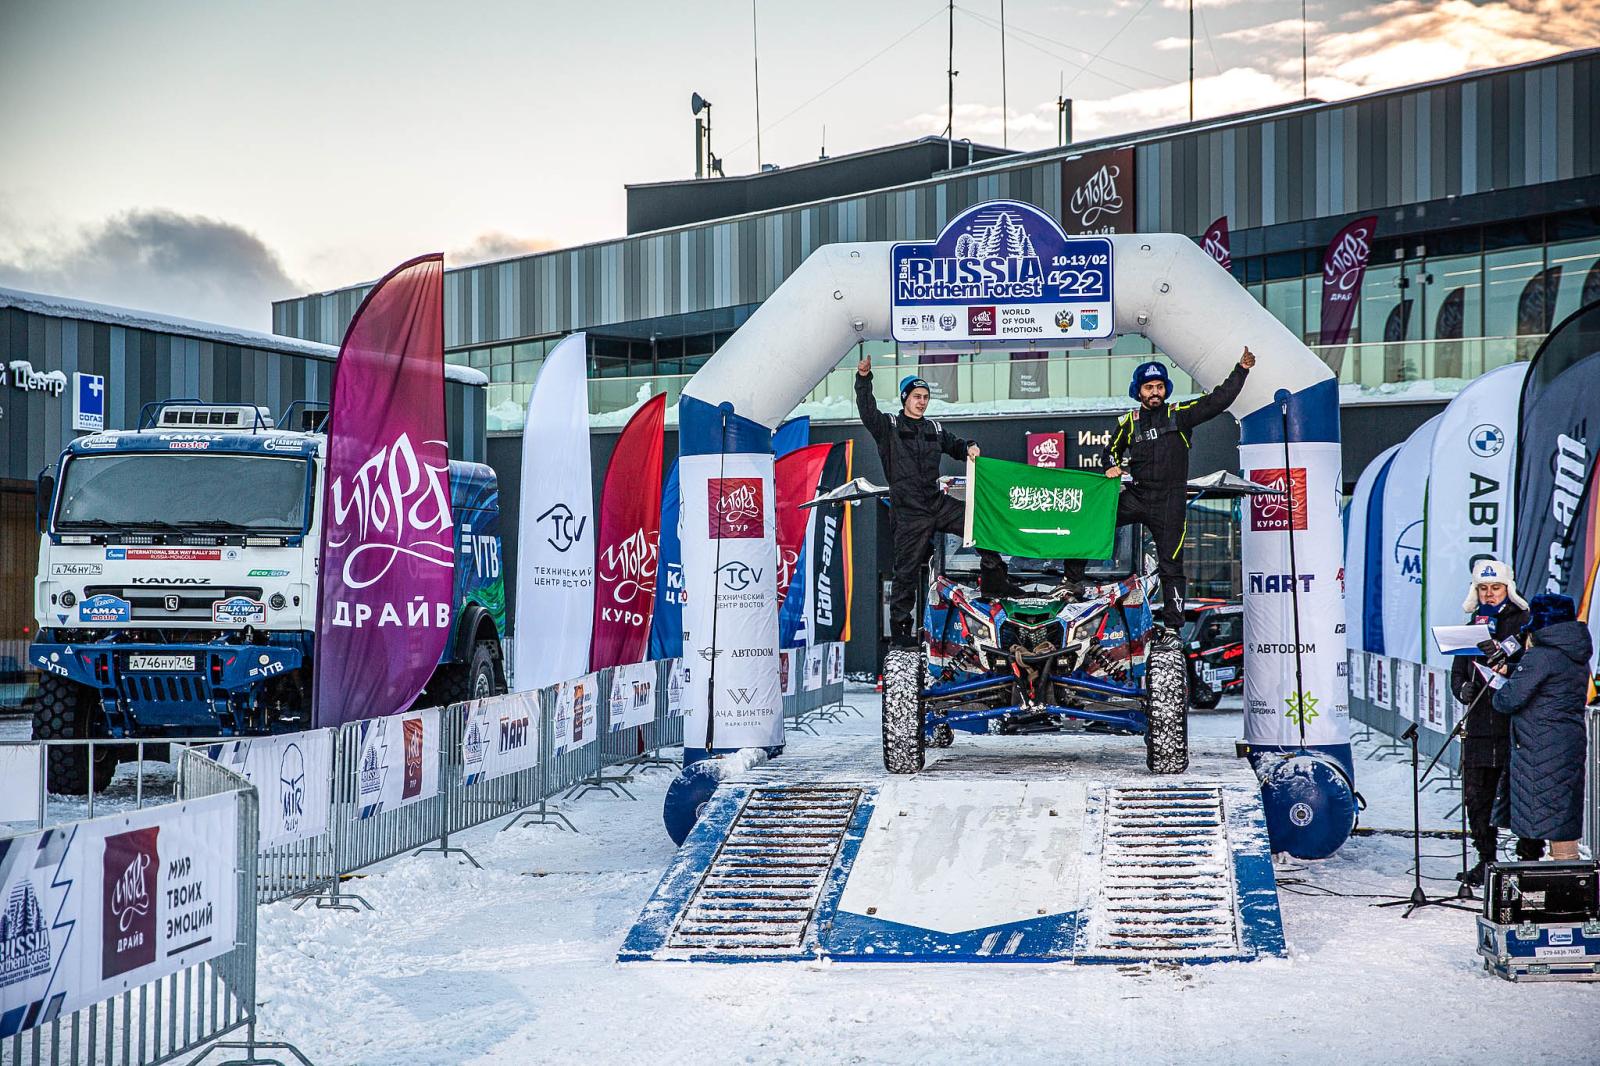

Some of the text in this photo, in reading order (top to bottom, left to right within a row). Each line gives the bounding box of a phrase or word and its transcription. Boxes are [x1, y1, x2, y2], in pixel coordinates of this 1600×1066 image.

[1052, 255, 1108, 266] 10-13/02
[908, 256, 1044, 285] RUSSIA
[898, 279, 1042, 299] Northern Forest
[1014, 317, 1035, 325] YOUR
[1002, 326, 1043, 334] EMOTIONS
[169, 441, 209, 449] master
[730, 524, 748, 532] ТУР
[472, 534, 500, 578] VTB
[131, 577, 211, 585] KAMAZ
[534, 577, 560, 587] ЦЕНТР
[332, 596, 450, 628] ДРАЙВ
[47, 661, 69, 676] VTB
[259, 661, 284, 676] VTB
[168, 856, 191, 881] МИР
[166, 881, 203, 910] ТВОИХ
[166, 901, 214, 940] ЭМОЦИЙ
[116, 930, 145, 953] ДРАЙВ
